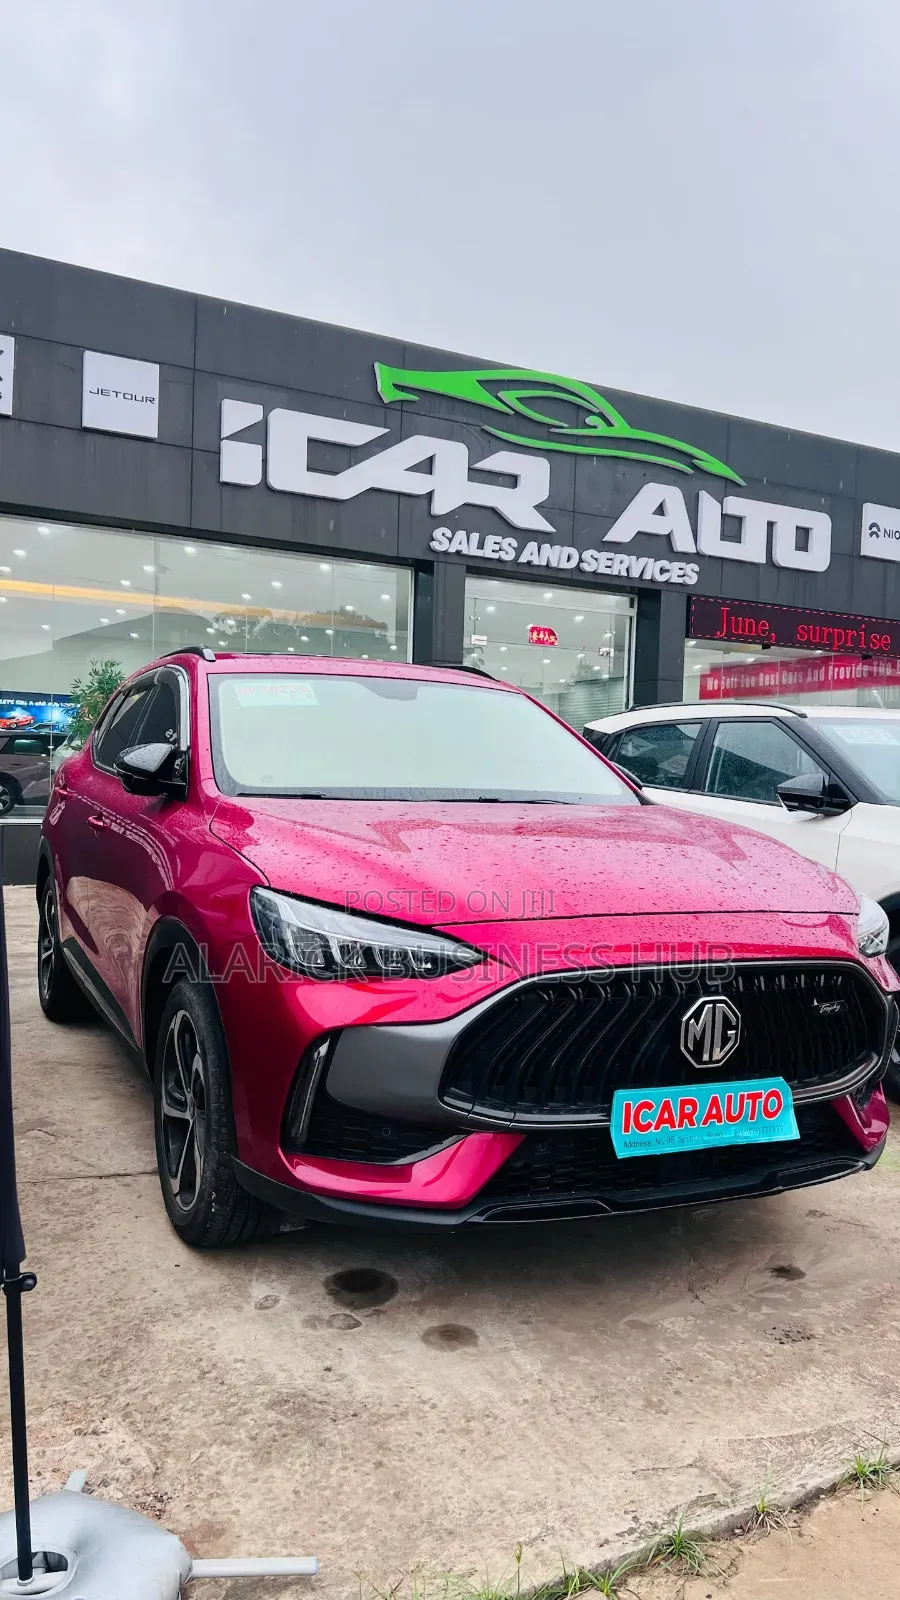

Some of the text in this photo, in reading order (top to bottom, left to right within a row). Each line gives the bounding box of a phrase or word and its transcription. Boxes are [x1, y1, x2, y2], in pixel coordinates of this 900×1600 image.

[89, 387, 155, 404] JETOUR
[883, 528, 900, 540] NIO
[430, 527, 700, 585] SALES AND SERVICES
[716, 607, 891, 650] June, surprise
[706, 677, 719, 691] We
[758, 671, 779, 687] Best
[782, 669, 803, 685] Cars
[806, 666, 825, 682] And
[828, 662, 868, 680] Provide
[684, 1000, 738, 1064] MG
[622, 1088, 784, 1134] ICAR AUTO
